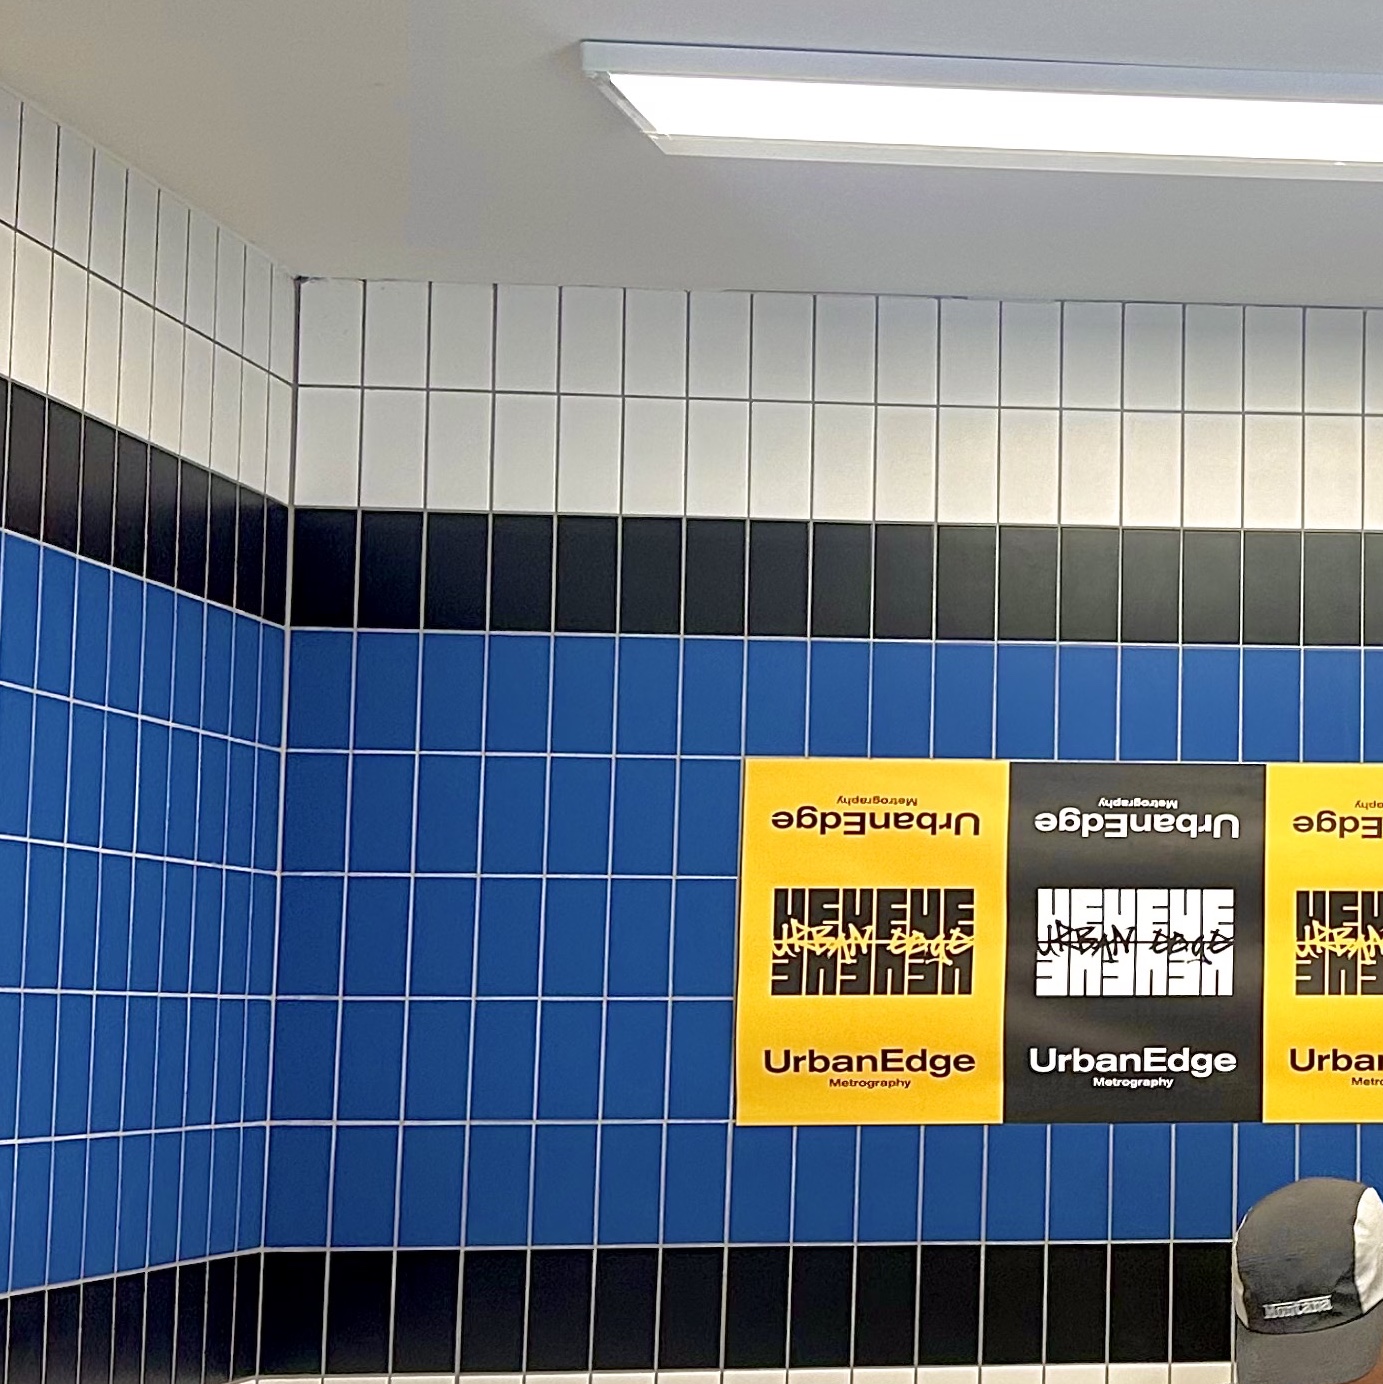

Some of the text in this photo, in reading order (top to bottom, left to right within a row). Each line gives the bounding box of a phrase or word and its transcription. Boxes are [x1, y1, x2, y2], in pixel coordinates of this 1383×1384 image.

[836, 795, 917, 806] Metrography
[1098, 798, 1178, 809] Metrography
[771, 806, 980, 835] UrbanEdge
[1035, 808, 1239, 838] UrbanEdge
[765, 1048, 975, 1077] UrbanEdge
[1031, 1048, 1237, 1077] UrbanEdge
[829, 1078, 911, 1089] Metrography
[1093, 1077, 1174, 1088] Metrography
